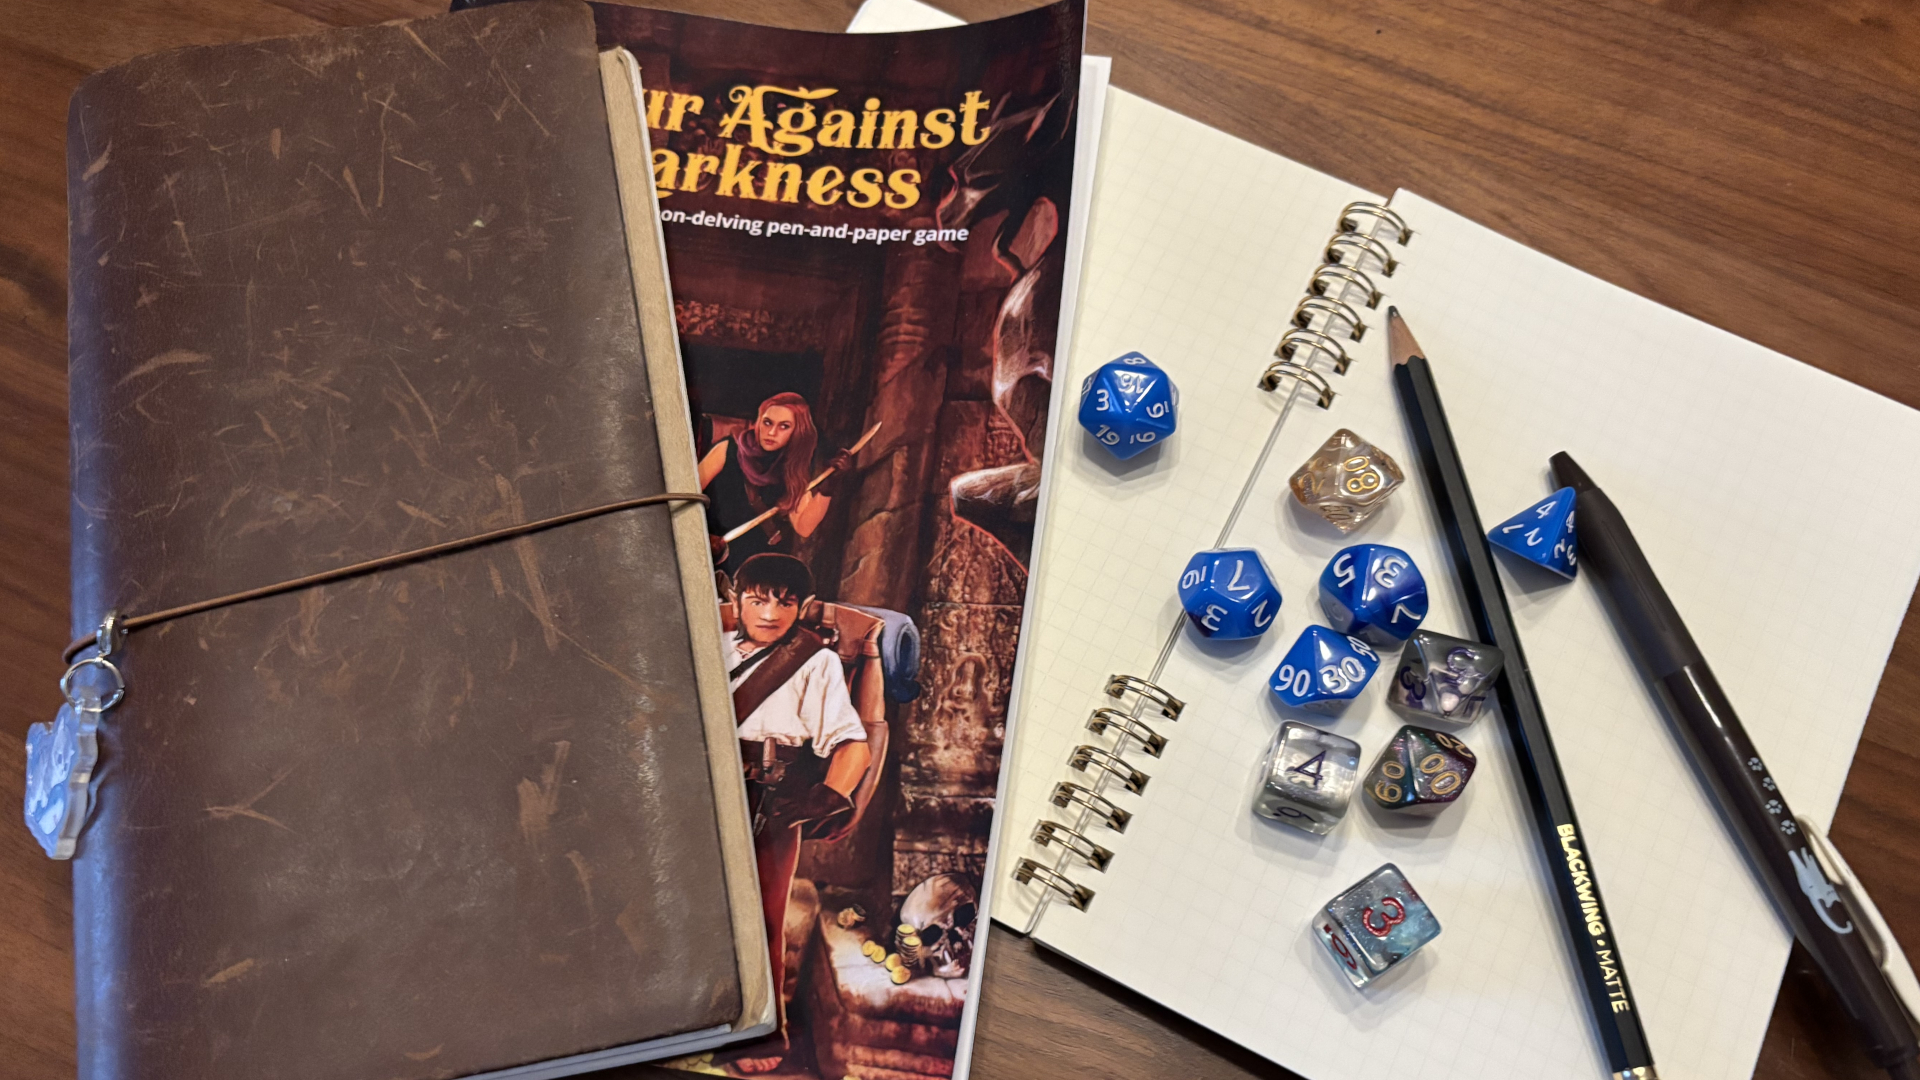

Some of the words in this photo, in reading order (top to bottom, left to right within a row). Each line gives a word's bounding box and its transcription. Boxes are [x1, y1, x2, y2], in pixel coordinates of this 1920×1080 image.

[643, 89, 704, 132] ur
[718, 85, 991, 157] Against
[651, 144, 922, 209] arkness
[660, 209, 763, 236] on-delving
[766, 222, 910, 244] pen-and-paper
[912, 226, 970, 246] game
[1096, 389, 1110, 412] 3
[1095, 424, 1120, 446] 19
[1536, 501, 1557, 519] 4
[1566, 511, 1575, 533] 4
[1523, 527, 1544, 547] 2
[1553, 538, 1566, 559] 2
[1332, 552, 1357, 588] 5
[1374, 555, 1409, 589] 3
[1566, 544, 1577, 567] 3
[1226, 559, 1251, 592] 7
[1200, 603, 1229, 632] 3
[1250, 598, 1272, 628] 2
[1390, 602, 1422, 624] 7
[1274, 664, 1311, 698] 90
[1319, 656, 1366, 694] 30
[1293, 749, 1327, 786] 4
[1361, 896, 1407, 938] 3
[1556, 823, 1607, 937] BLACKWING
[1596, 949, 1630, 1014] MATTE
